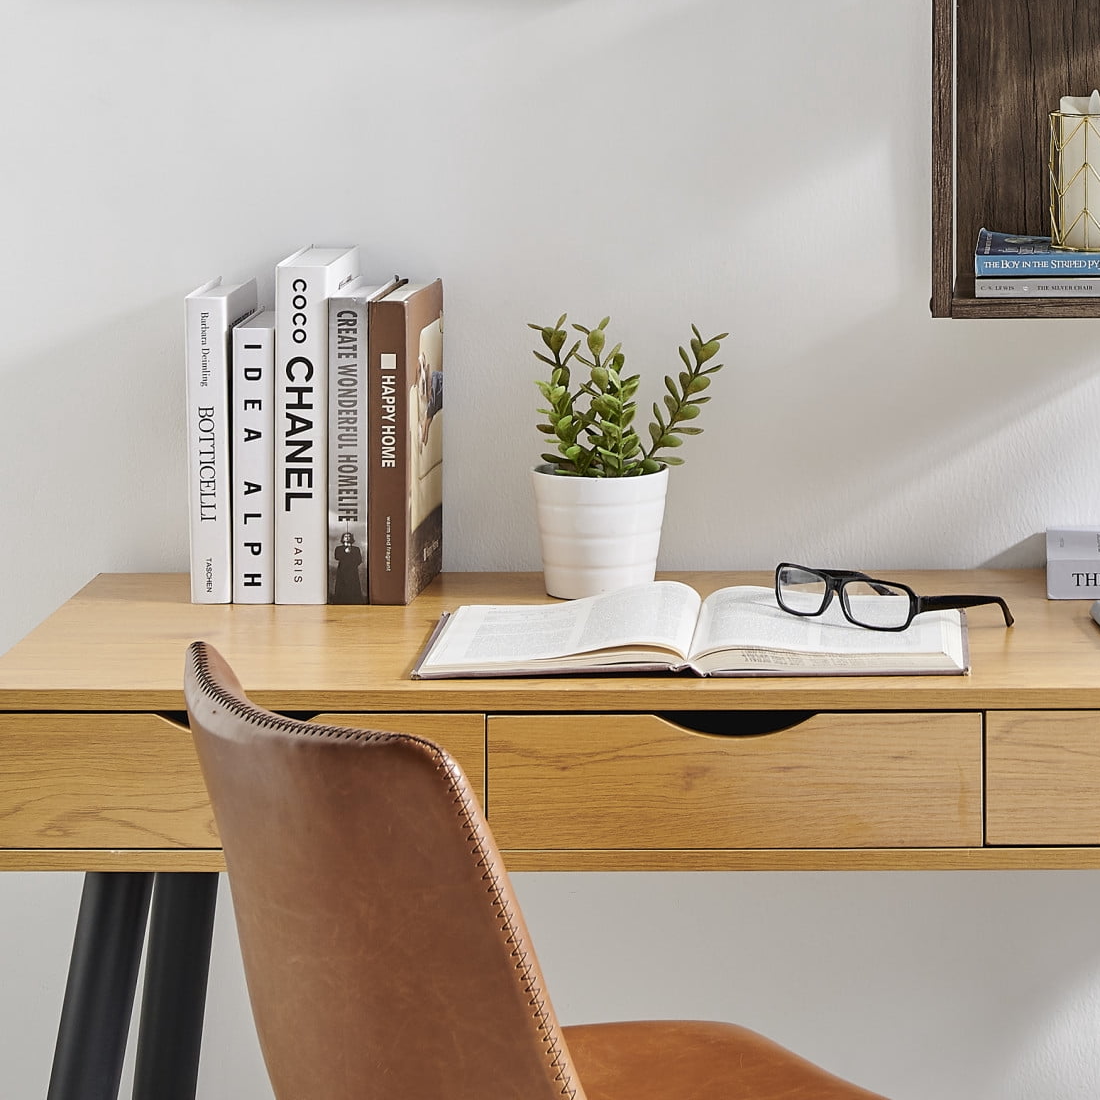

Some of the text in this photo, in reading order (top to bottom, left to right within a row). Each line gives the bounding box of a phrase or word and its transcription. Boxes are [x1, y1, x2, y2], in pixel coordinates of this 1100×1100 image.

[983, 261, 1000, 269] THE
[1050, 259, 1087, 269] STRIPED
[200, 312, 211, 387] Barbara Deimling
[336, 310, 358, 359] CREATE
[285, 278, 314, 512] COCO CHANEL
[337, 363, 358, 449] WONDERFUL
[381, 375, 396, 468] HAPPY HOME
[198, 406, 217, 522] BOTTICELLI
[337, 454, 359, 522] HOMELIFE
[205, 557, 213, 594] TASCHEN
[293, 536, 303, 584] PARIS
